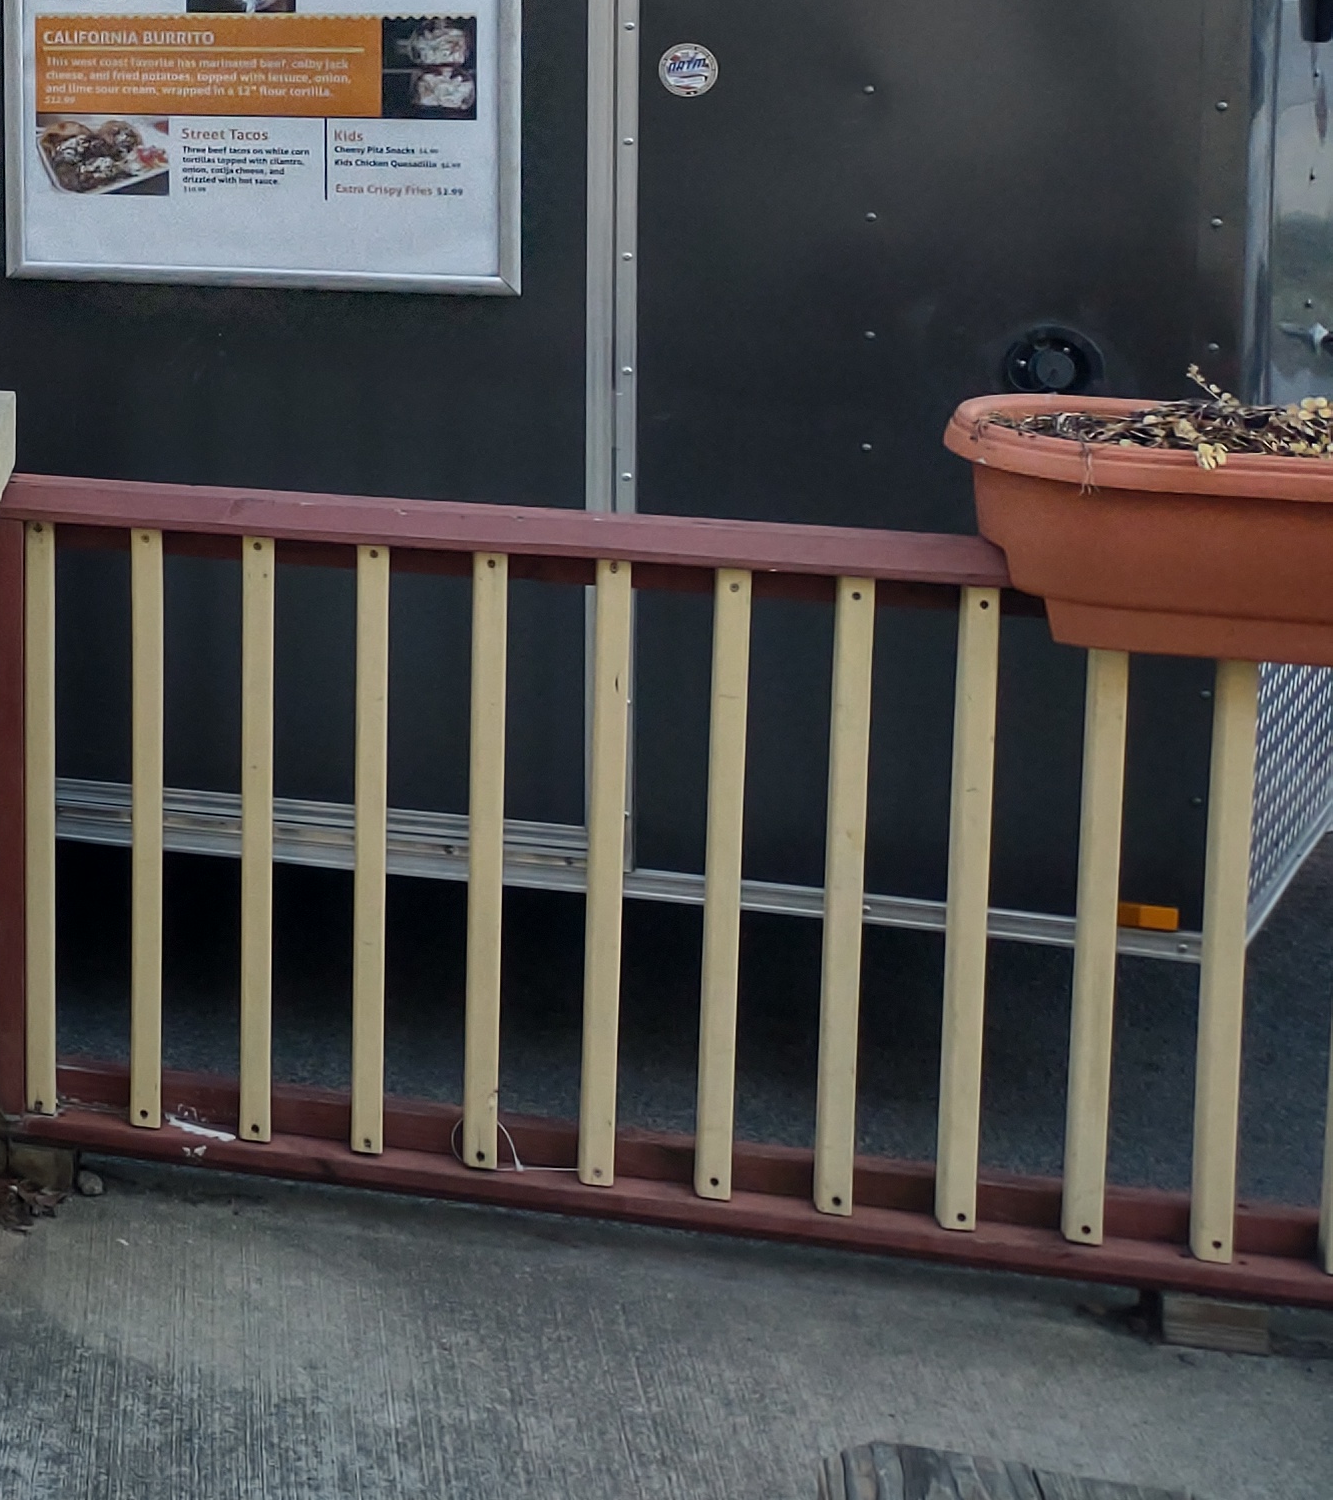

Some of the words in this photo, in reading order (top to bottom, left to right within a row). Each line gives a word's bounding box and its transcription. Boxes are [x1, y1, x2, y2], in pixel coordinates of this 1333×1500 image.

[43, 31, 139, 44] CALIFORNIA
[143, 31, 215, 45] BURRITO
[182, 128, 225, 140] Street
[229, 129, 268, 140] Tacos
[334, 130, 363, 141] Kids
[367, 146, 383, 154] Pita
[355, 159, 388, 167] Chicken
[391, 160, 437, 168] Quesadilla
[336, 184, 364, 194] Extra
[367, 185, 402, 197] Crispy
[405, 185, 433, 195] Fries
